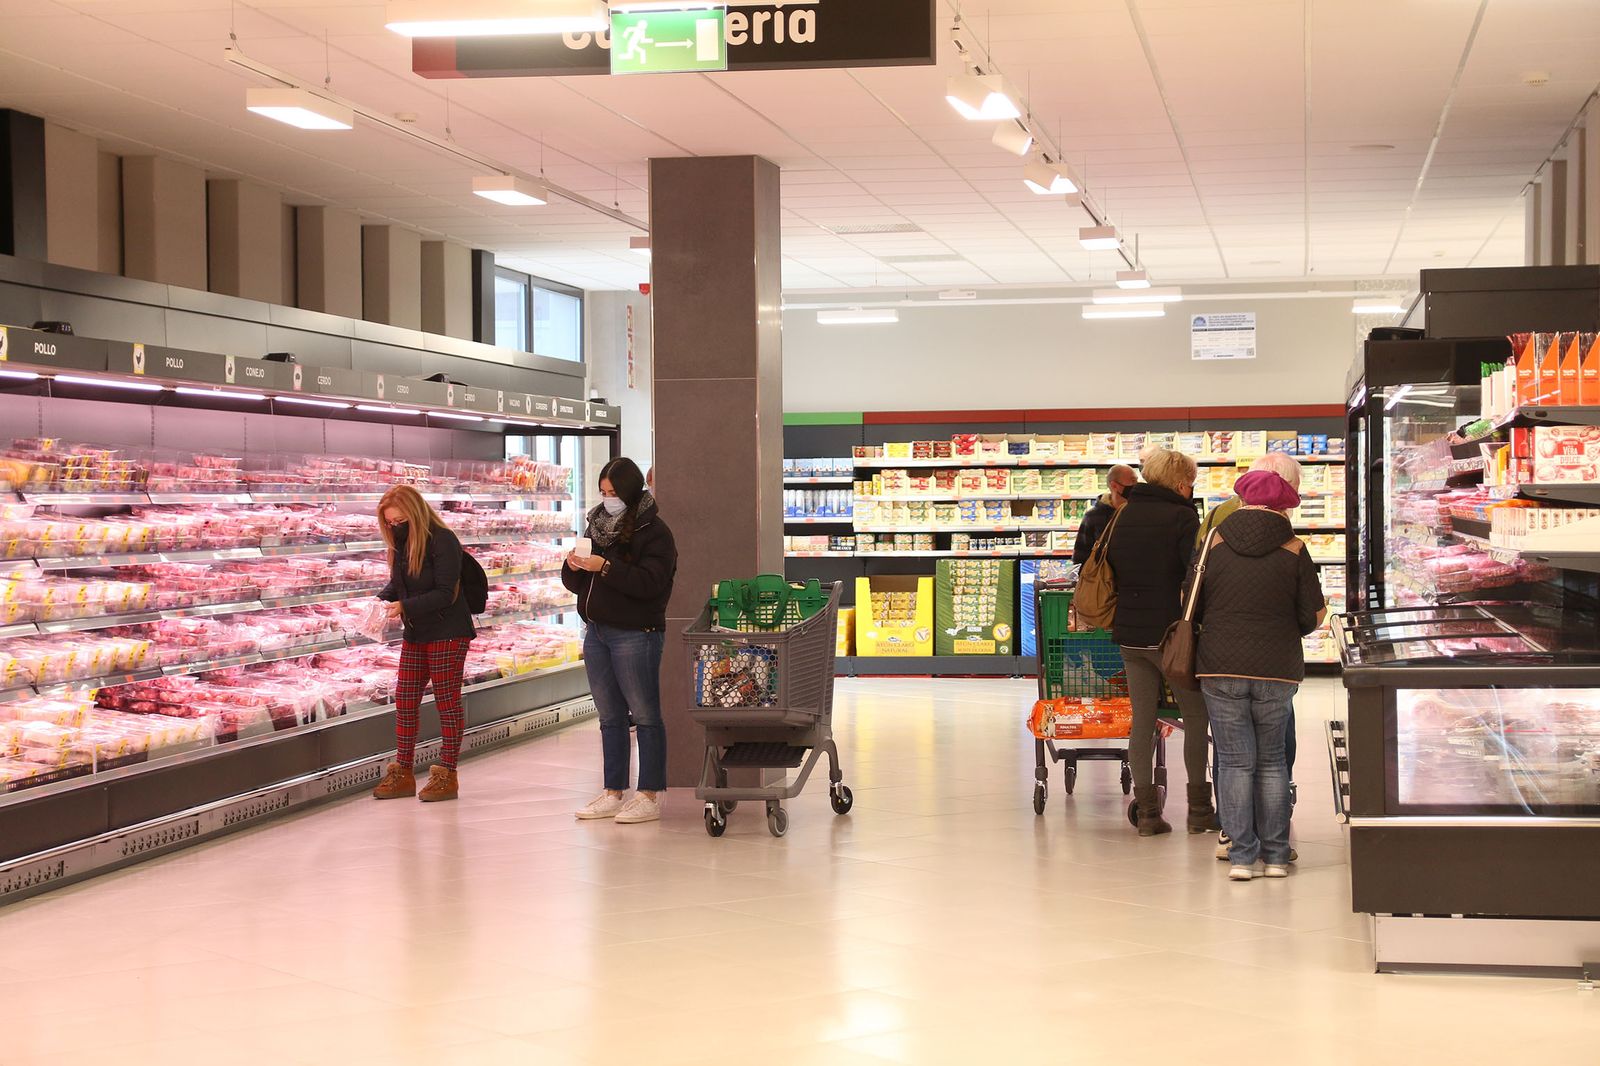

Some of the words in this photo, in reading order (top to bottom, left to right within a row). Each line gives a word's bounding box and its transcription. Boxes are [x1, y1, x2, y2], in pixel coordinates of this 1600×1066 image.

[34, 342, 56, 356] POLLO
[166, 357, 184, 369] POLLO
[245, 366, 265, 379] CONEJO
